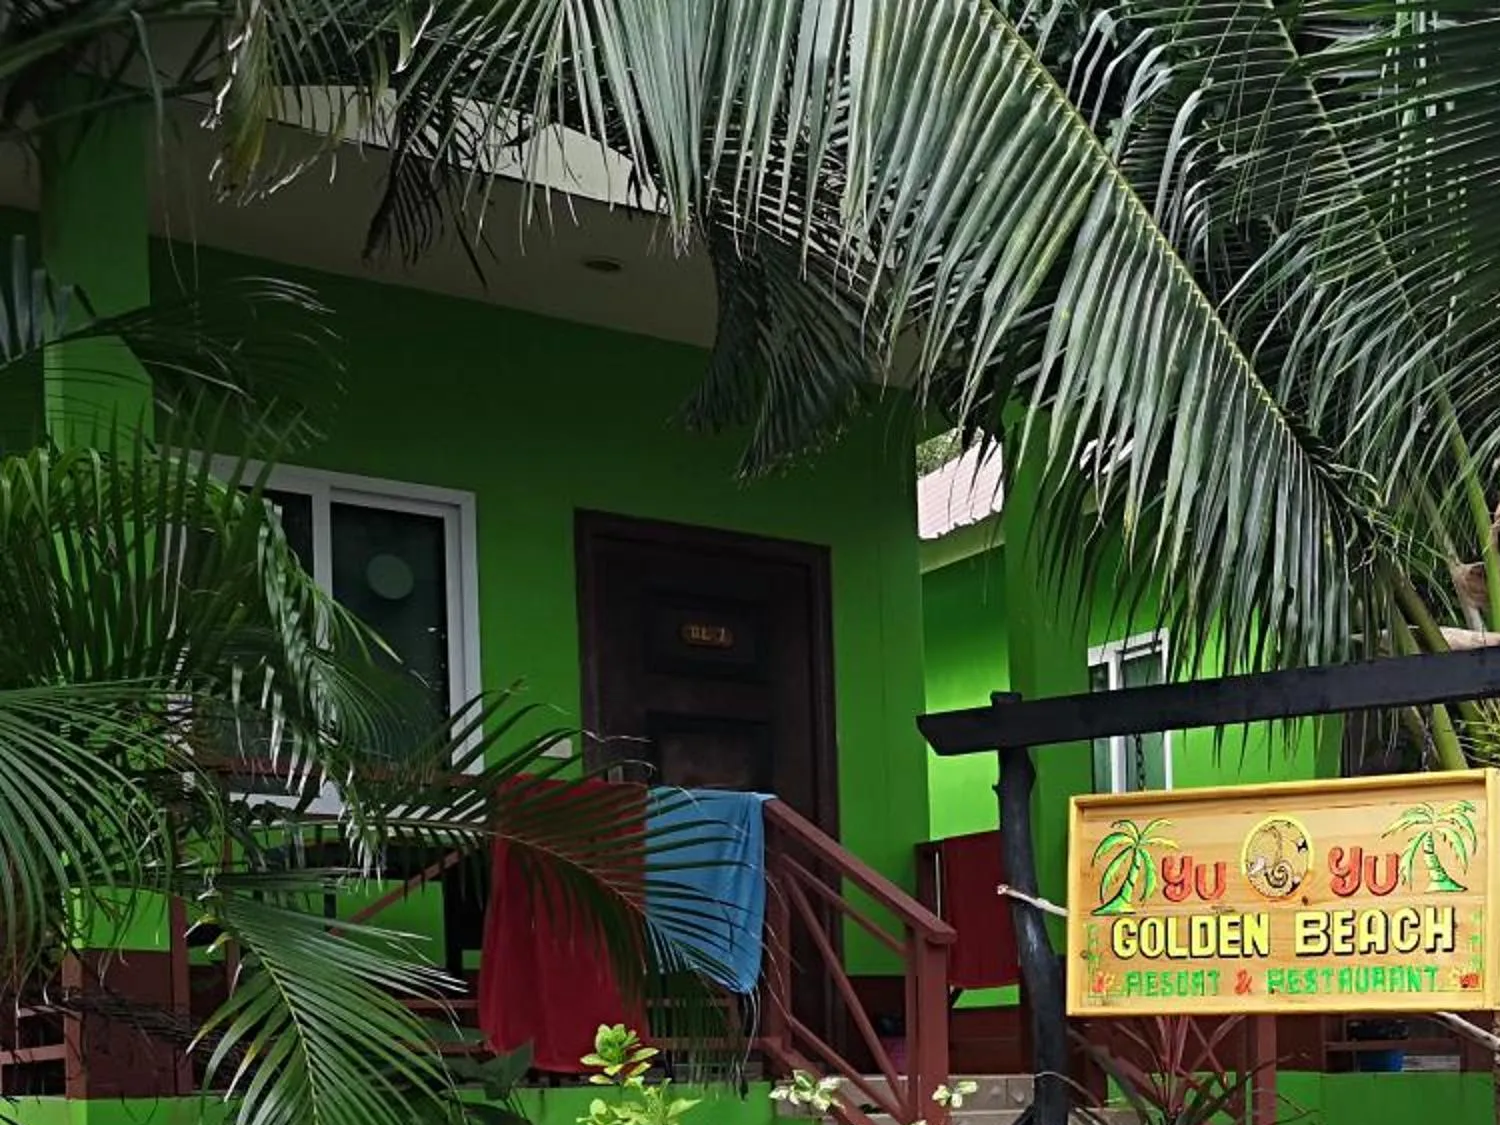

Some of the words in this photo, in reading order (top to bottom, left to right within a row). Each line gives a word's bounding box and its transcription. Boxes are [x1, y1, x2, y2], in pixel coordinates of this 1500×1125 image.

[1111, 912, 1270, 960] GOLDEN
[1294, 905, 1456, 957] BEACH
[1125, 968, 1221, 998] RESORT
[1234, 969, 1253, 995] &
[1267, 964, 1439, 996] RESTAURANT
